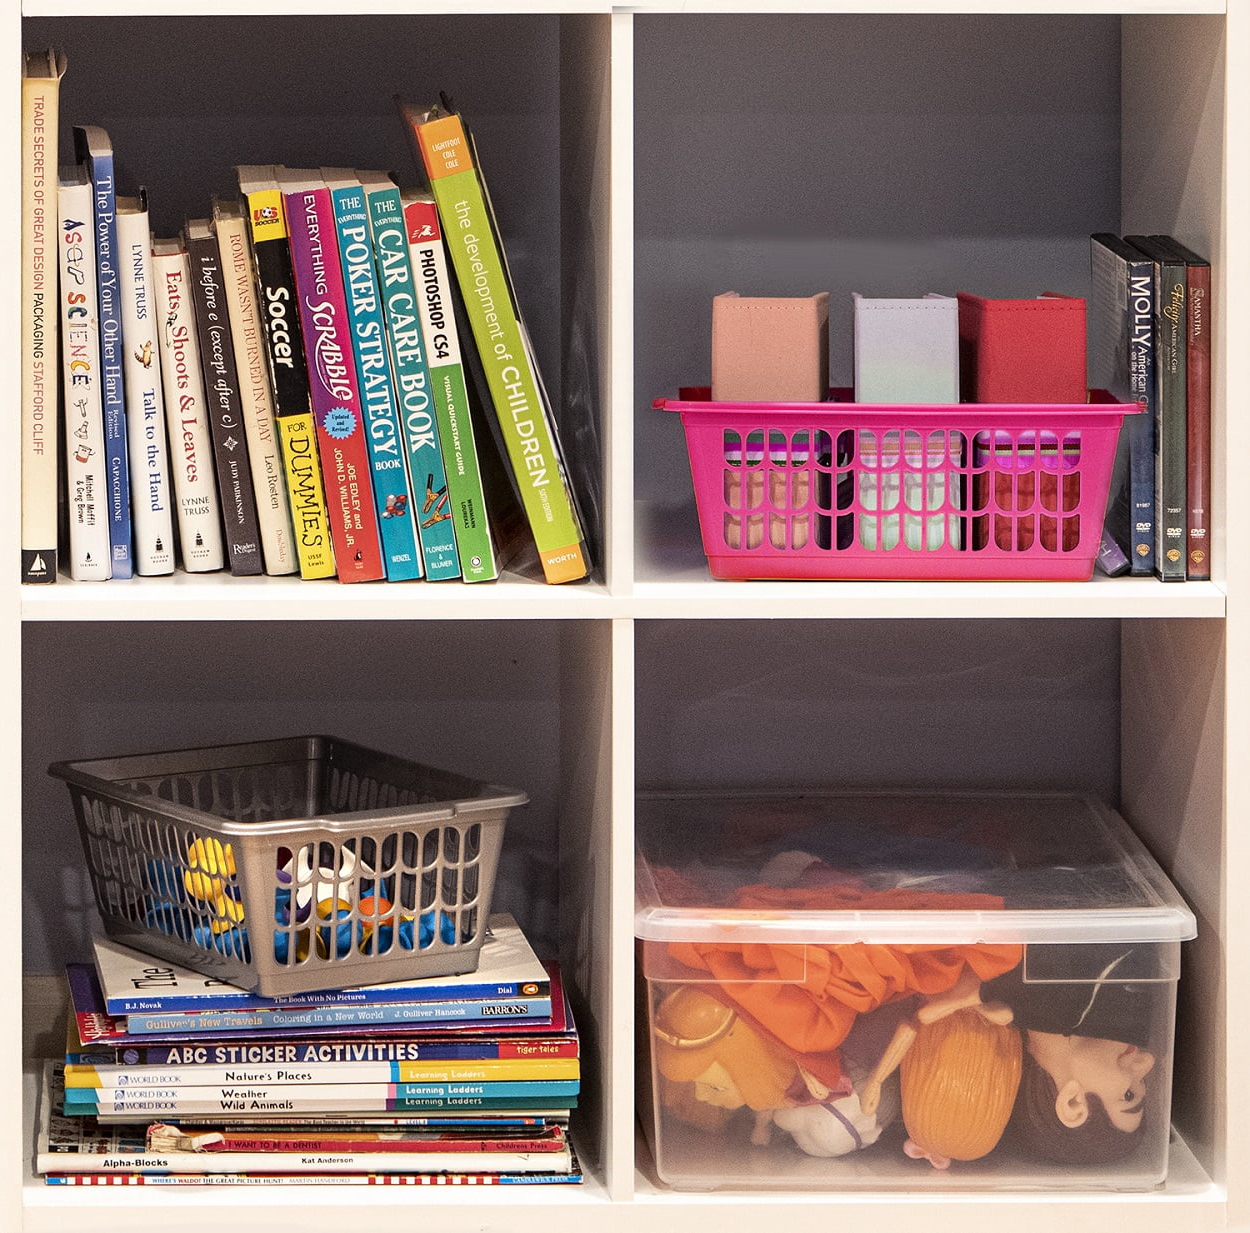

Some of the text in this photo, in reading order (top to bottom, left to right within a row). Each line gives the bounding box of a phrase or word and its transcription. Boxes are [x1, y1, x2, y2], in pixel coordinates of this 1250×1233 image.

[33, 95, 45, 456] TRADE SECRETS OF GREAT DESIGN PACKAGING STAFFORD CLIFF
[303, 195, 328, 295] EVERYTHING
[267, 286, 295, 368] Soccer
[343, 226, 391, 454] POKER STRATEGY
[378, 230, 436, 453] CAR CARE BOOK
[420, 249, 449, 359] PHOTOSHOP CS4
[455, 201, 550, 488] the development of CHILDREN
[1131, 276, 1151, 346] MOLLY
[289, 436, 322, 547] DUMMIES
[498, 986, 512, 994] Dial
[167, 1044, 419, 1063] ABC STICKER ACTIVITIES
[406, 1085, 483, 1095] Learning Ladders
[517, 1044, 558, 1054] tiger tales
[222, 1090, 267, 1099] Weather
[103, 1159, 168, 1168] Alpha-Blocks
